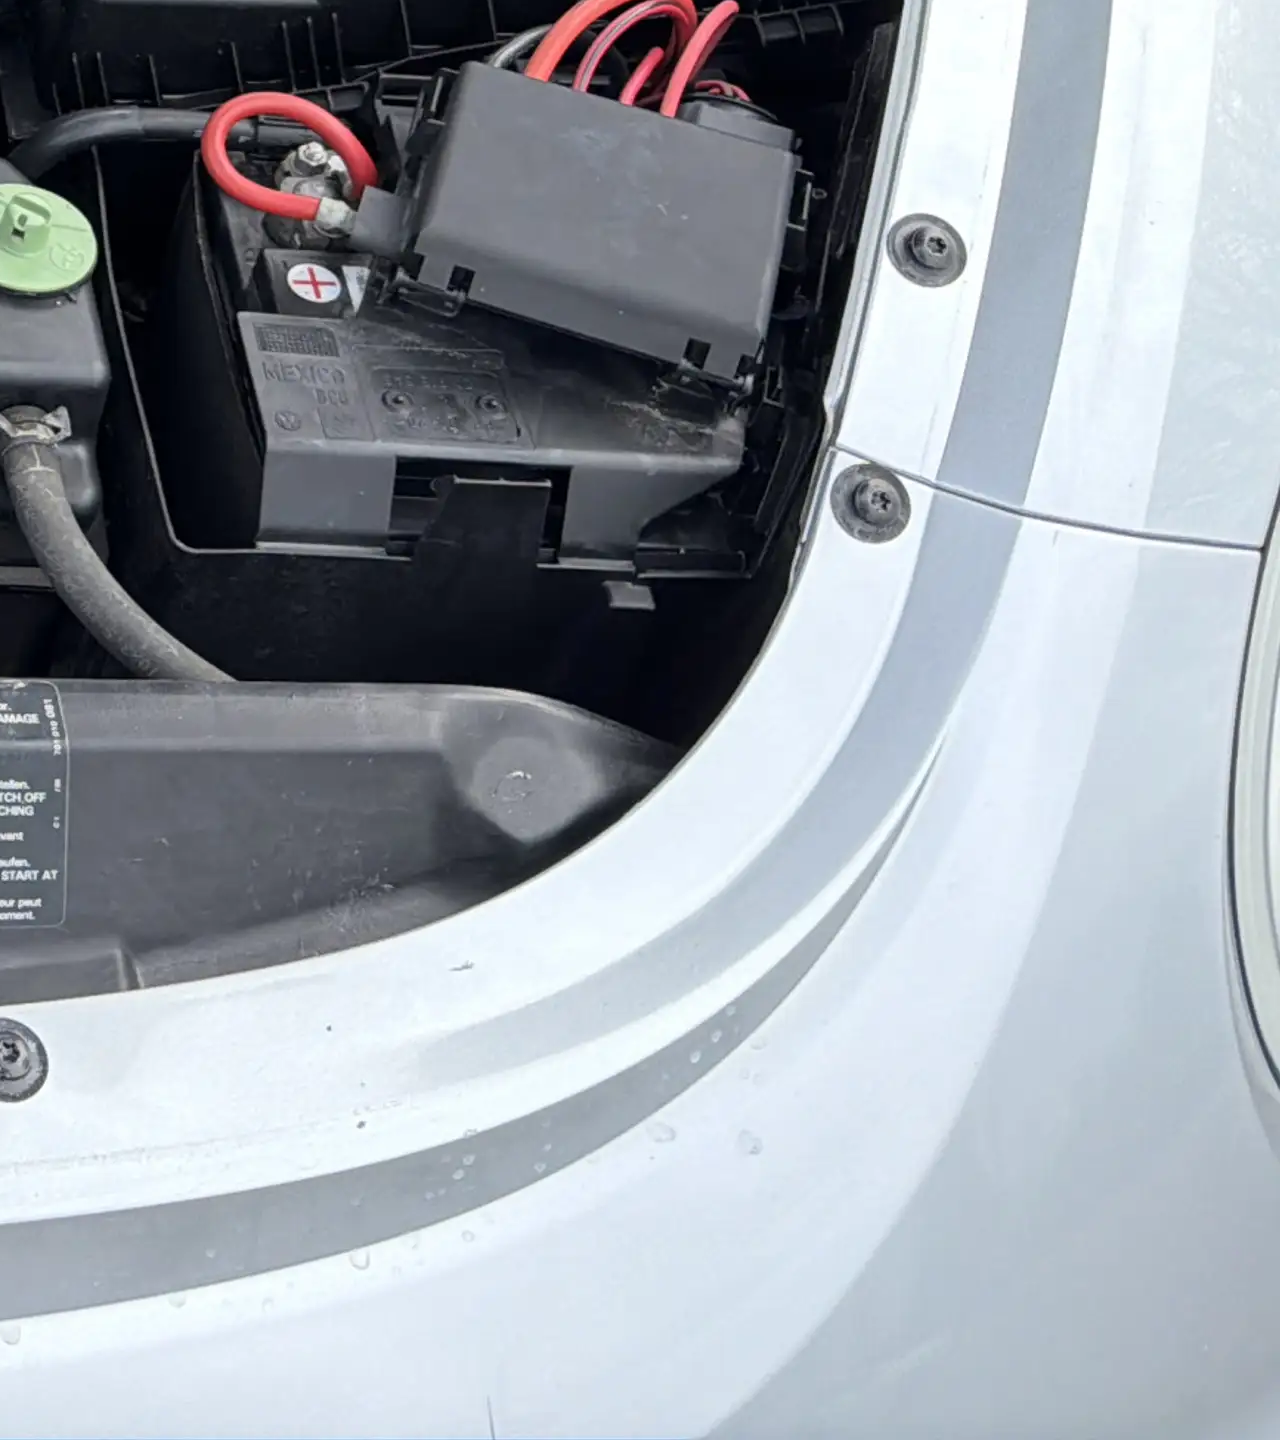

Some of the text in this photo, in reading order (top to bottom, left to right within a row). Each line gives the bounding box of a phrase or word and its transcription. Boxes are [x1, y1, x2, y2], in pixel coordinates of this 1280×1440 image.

[262, 362, 345, 385] MEXICO
[24, 792, 47, 803] OFF
[0, 870, 40, 881] START
[41, 870, 58, 880] AT
[17, 898, 42, 910] peut
